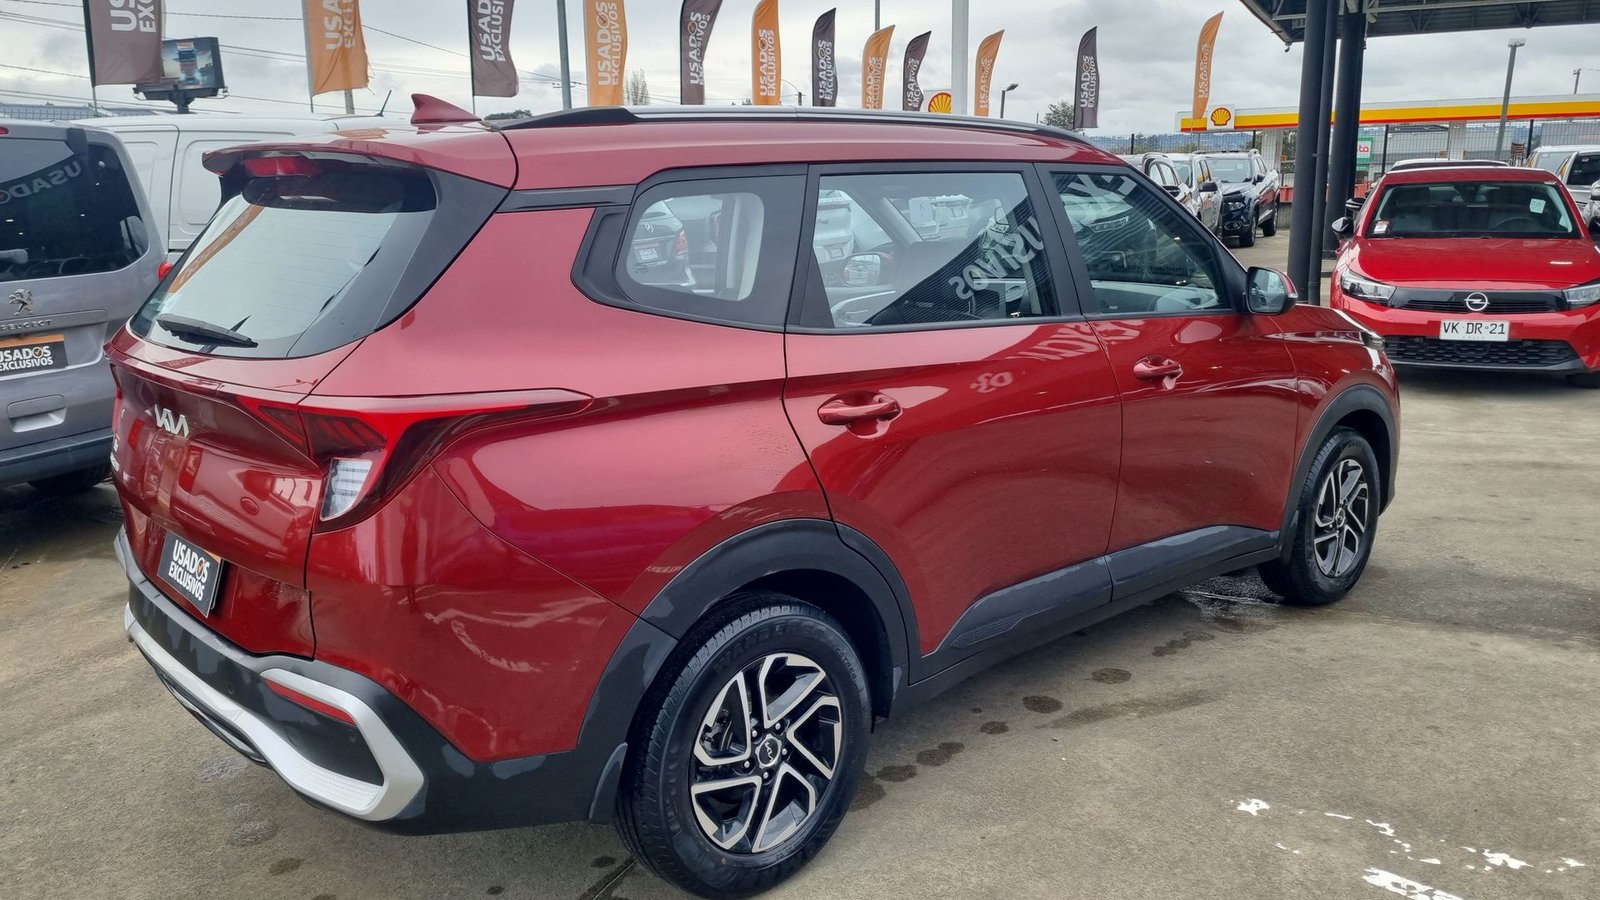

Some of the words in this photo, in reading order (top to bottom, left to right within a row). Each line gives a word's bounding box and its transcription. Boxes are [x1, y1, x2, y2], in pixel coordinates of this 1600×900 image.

[596, 2, 610, 85] USADOS
[608, 2, 622, 86] EXCLUSIVOS
[686, 12, 701, 85] USADOS
[759, 28, 768, 96] USADOS
[767, 30, 775, 97] EXCLUSIVOS
[818, 40, 827, 99] USADOS
[823, 42, 833, 100] EXCLUSIVOS
[872, 57, 883, 108] XCLUSIVOS
[1080, 55, 1090, 108] USADOS
[1087, 56, 1097, 108] EXCLUSIVOS
[1443, 322, 1459, 334] VK
[1466, 322, 1483, 335] DR
[1489, 323, 1505, 335] 21
[168, 560, 206, 601] EXCLUSIVOS
[172, 539, 211, 584] USADOS
